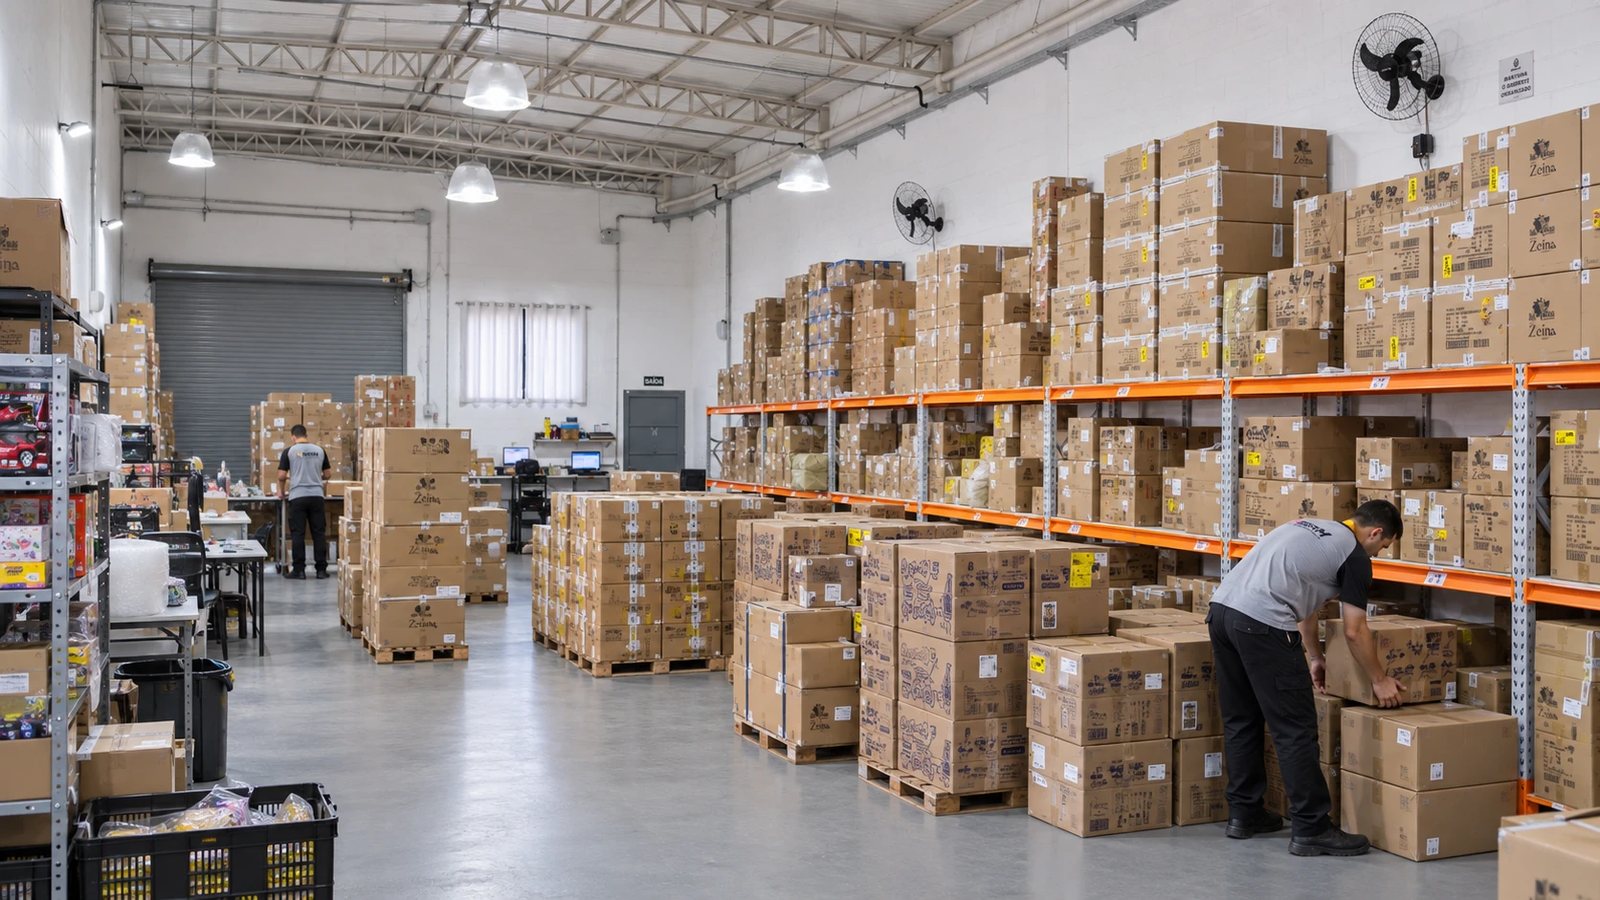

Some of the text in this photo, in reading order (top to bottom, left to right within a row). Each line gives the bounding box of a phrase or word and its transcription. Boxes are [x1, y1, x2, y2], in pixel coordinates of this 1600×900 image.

[1529, 162, 1557, 177] Zeina
[1529, 239, 1557, 253] Zeina
[1528, 323, 1557, 338] Zeina
